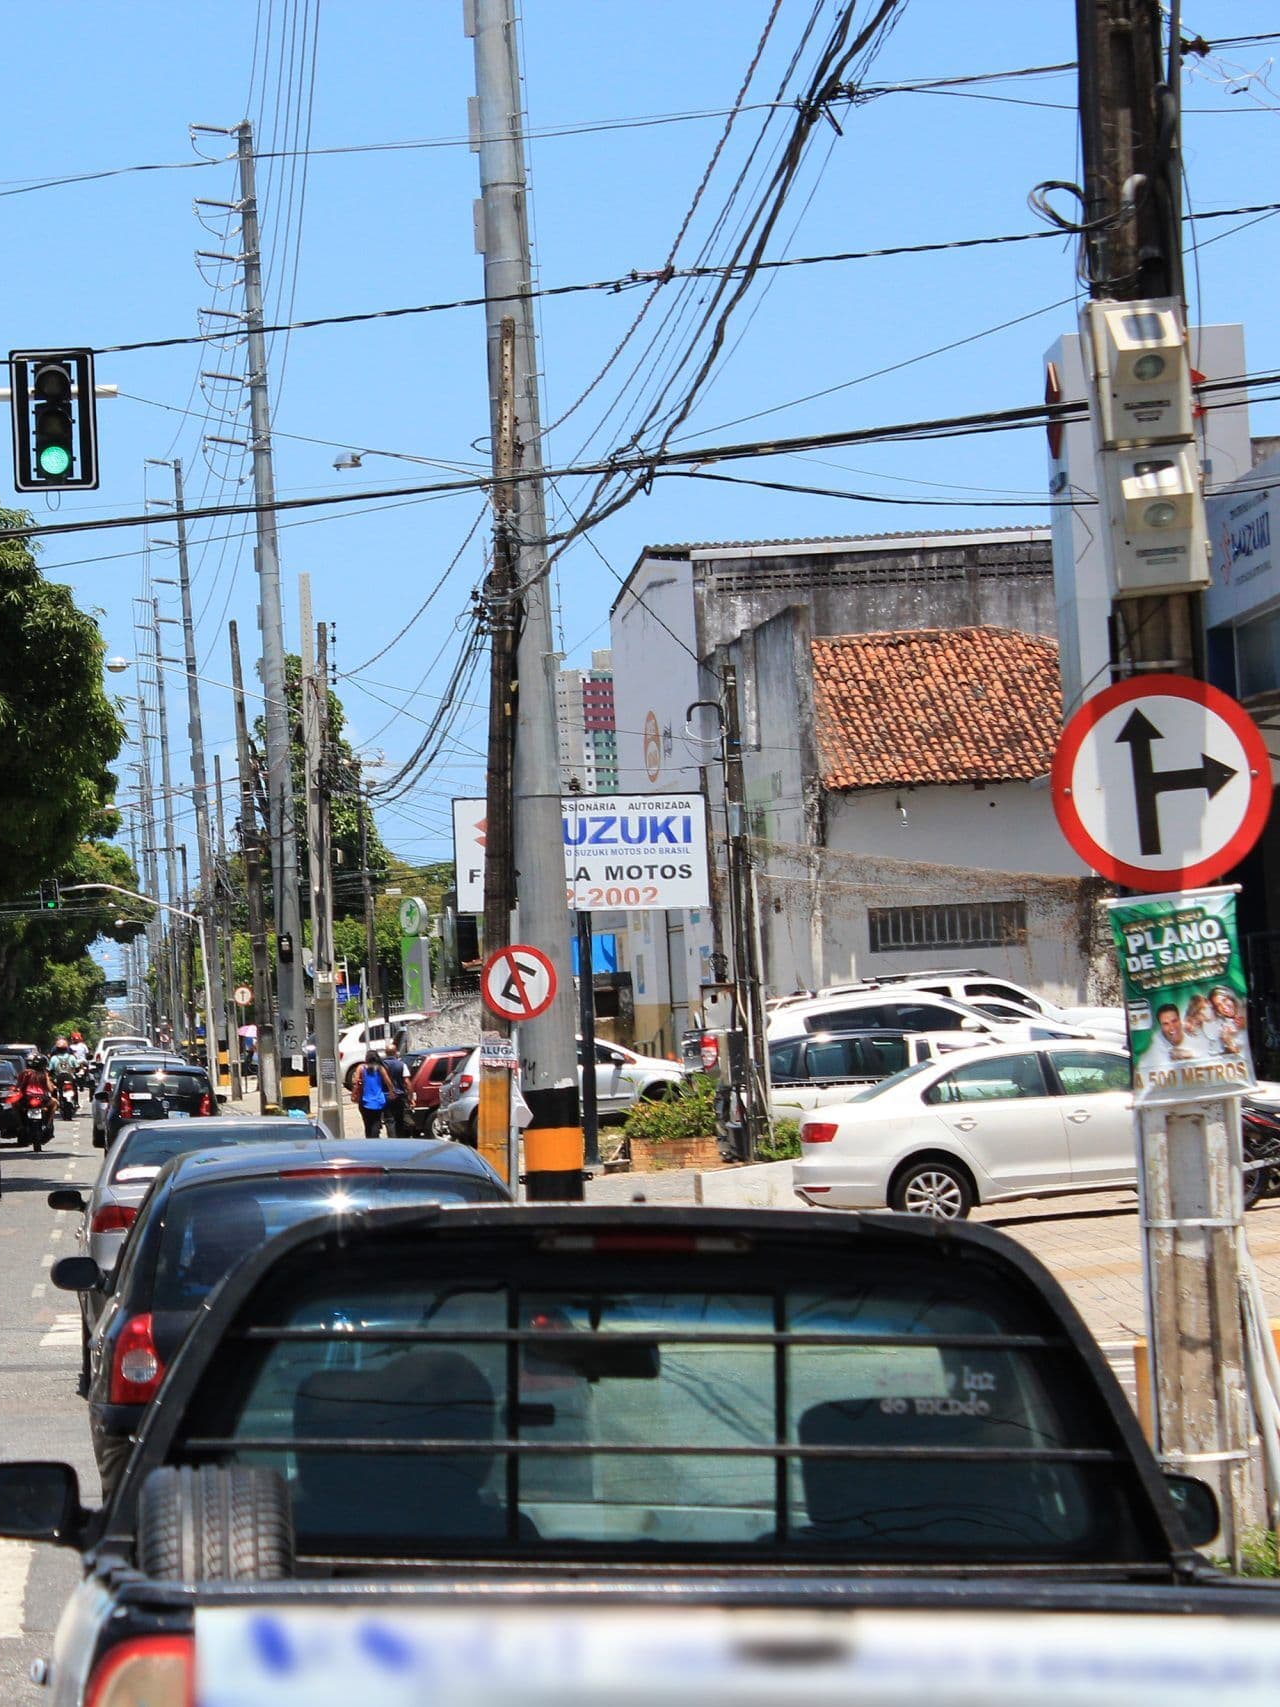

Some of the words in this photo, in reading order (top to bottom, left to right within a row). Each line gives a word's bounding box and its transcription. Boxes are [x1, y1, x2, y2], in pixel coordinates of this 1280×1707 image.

[561, 803, 617, 812] SSIONARIA
[628, 801, 692, 810] AUTORIZADA
[562, 815, 692, 846] UZUKI
[574, 848, 609, 857] SUZUKI
[610, 847, 642, 856] MOTOS
[643, 847, 657, 855] DO
[658, 846, 691, 855] BRASIL
[605, 864, 692, 880] MOTOS
[1126, 919, 1221, 954] PLANO
[1126, 953, 1156, 972] DE
[1148, 1069, 1177, 1088] 500
[1181, 1061, 1248, 1085] METROS
